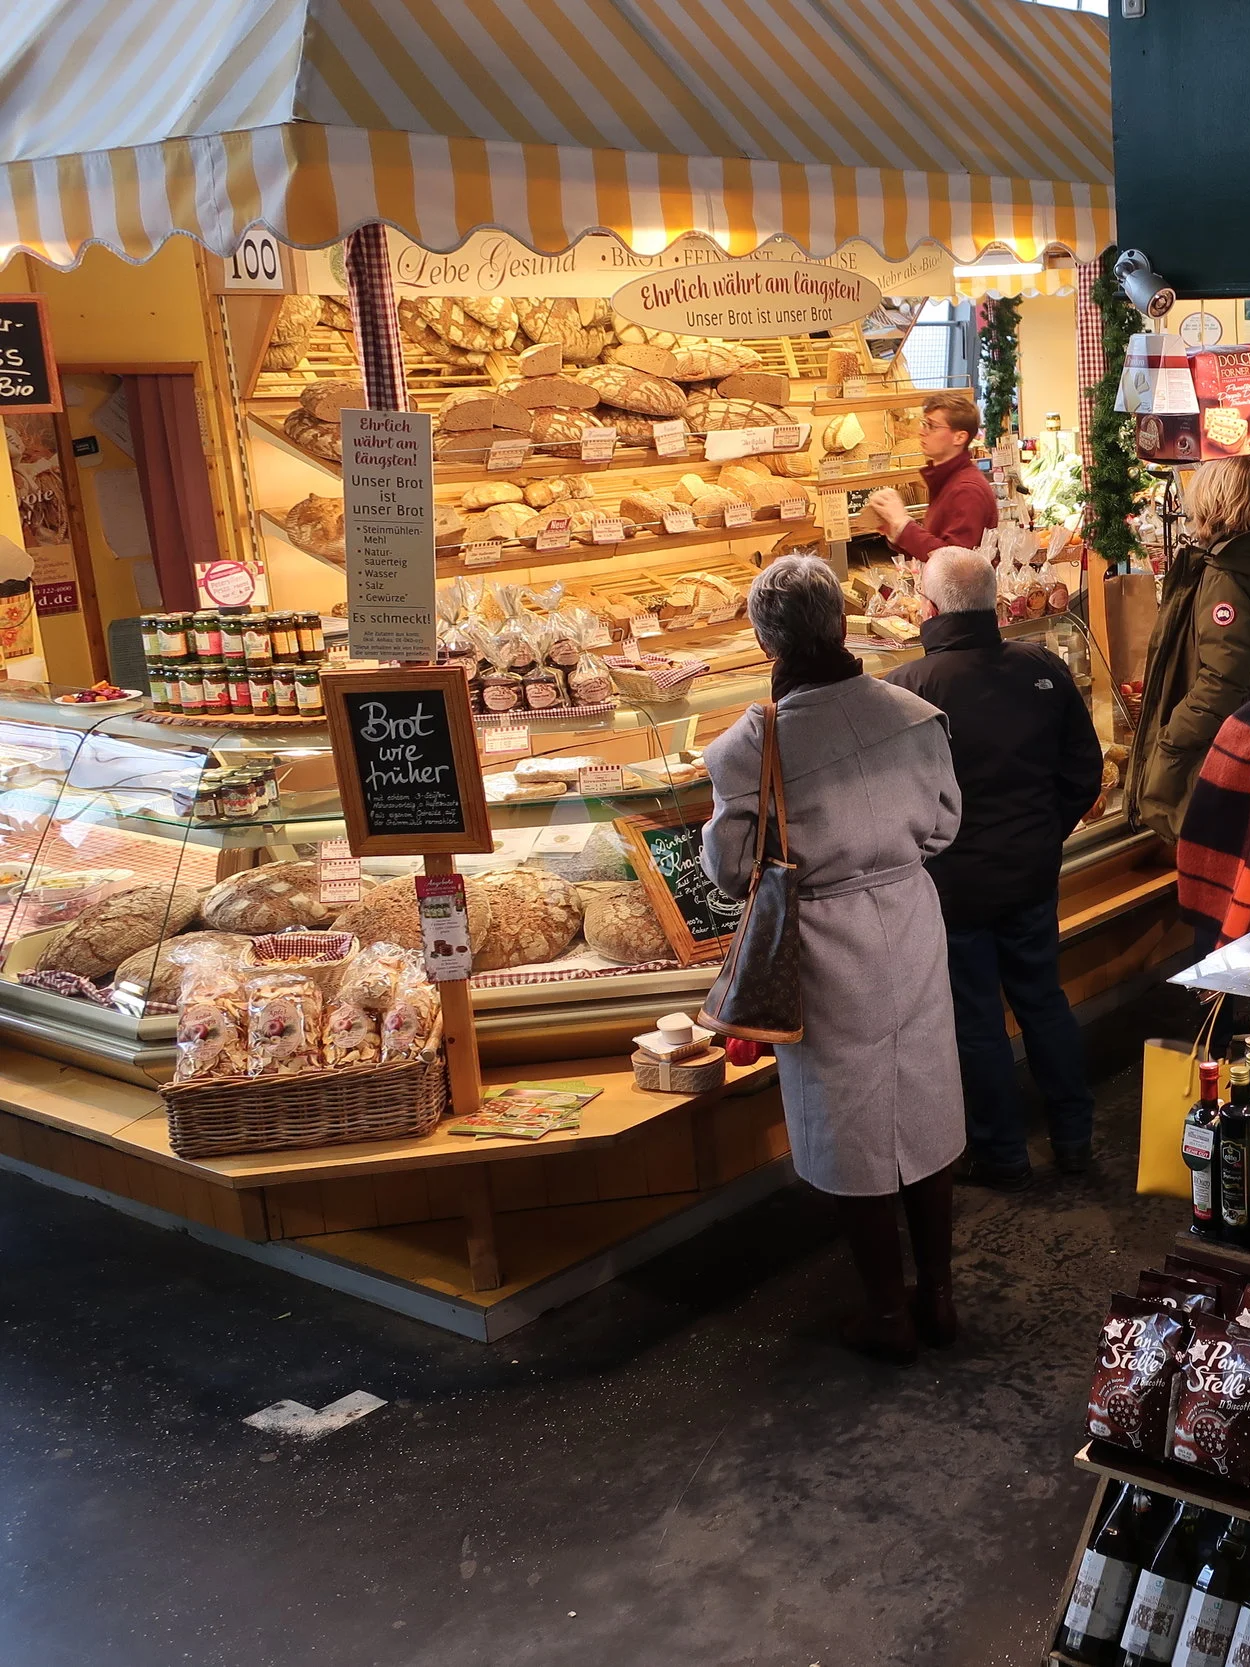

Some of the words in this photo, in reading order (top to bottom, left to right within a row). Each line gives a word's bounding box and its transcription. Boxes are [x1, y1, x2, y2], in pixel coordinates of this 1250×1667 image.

[231, 238, 277, 280] 100
[396, 245, 469, 288] Lebe
[477, 237, 576, 291] Gesund
[903, 261, 917, 279] als
[640, 274, 710, 311] Ehrlich
[713, 270, 761, 298] währt
[765, 275, 790, 295] am
[794, 270, 861, 303] längsten!
[686, 310, 722, 328] Unser
[728, 309, 753, 325] Brot
[757, 307, 771, 324] ist
[776, 308, 807, 324] unser
[811, 306, 832, 322] Brot
[360, 417, 412, 433] Ehrlich
[353, 435, 394, 449] währt
[396, 439, 418, 450] am
[355, 450, 417, 470] längsten!
[352, 475, 391, 488] Unser
[396, 476, 424, 489] Brot
[380, 490, 397, 502] ist
[353, 504, 391, 515] unser
[397, 505, 425, 517] Brot
[363, 525, 423, 536] Steinmühlen-
[550, 520, 568, 530] Neu!
[364, 536, 387, 545] Mehl
[364, 547, 393, 557] Natur-
[365, 558, 408, 568] sauerteig
[365, 570, 398, 578] Wasser
[365, 581, 384, 590] Salz
[353, 612, 366, 623] Es
[370, 613, 431, 625] schmeckt!
[359, 702, 435, 742] Brot
[379, 744, 423, 761] wie
[366, 761, 450, 791] früher
[655, 829, 697, 854] Dinkel-
[1123, 1319, 1154, 1348] Pan
[1102, 1344, 1162, 1375] Stelle
[1208, 1341, 1241, 1373] Pan
[1140, 1377, 1166, 1387] Biscotto
[1186, 1365, 1250, 1400] Stelle
[1218, 1400, 1225, 1409] Il
